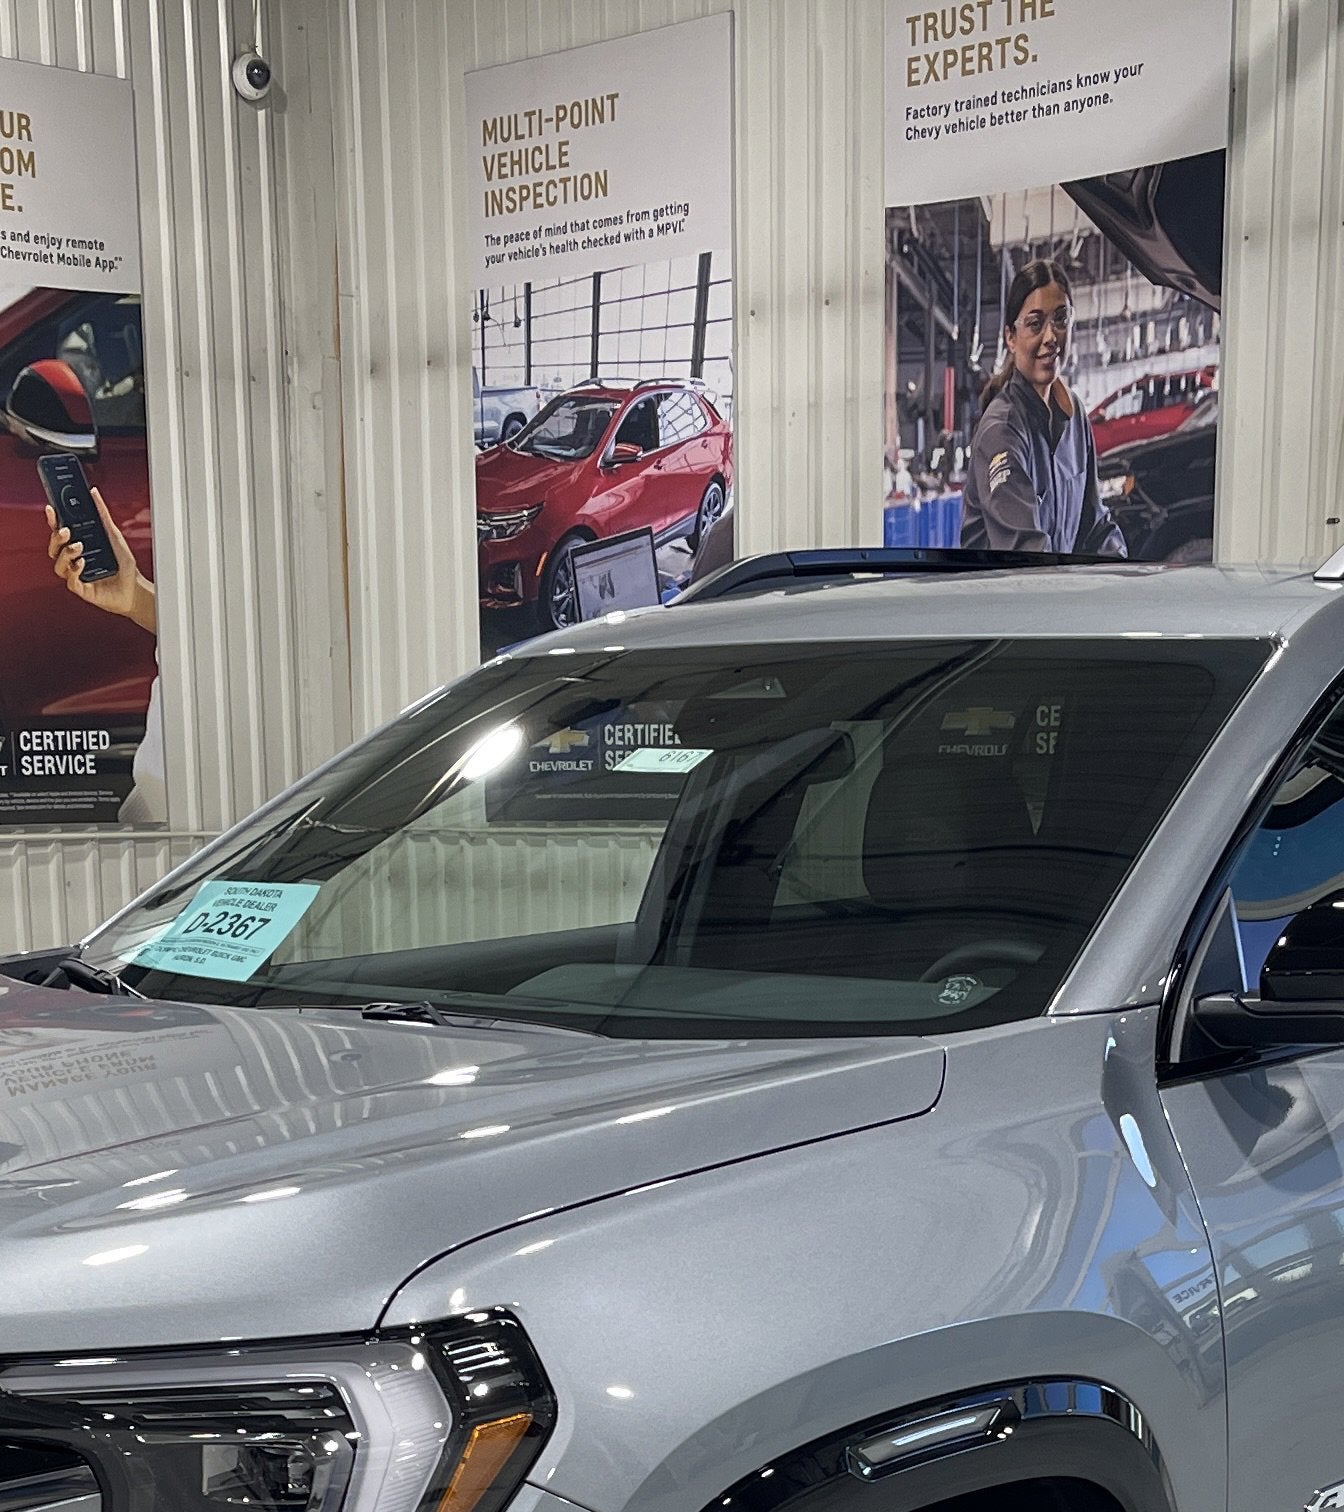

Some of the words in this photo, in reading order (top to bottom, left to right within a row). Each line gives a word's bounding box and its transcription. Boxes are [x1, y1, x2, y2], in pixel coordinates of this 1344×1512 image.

[906, 0, 993, 47] TRUST
[1000, 0, 1056, 27] THE
[907, 33, 1038, 87] EXPERTS.
[906, 101, 951, 121] Factory
[955, 91, 998, 112] trained
[1002, 79, 1073, 104] technicians
[1076, 70, 1110, 88] know
[1114, 63, 1145, 84] your
[482, 92, 619, 147] MULTI-POINT
[906, 124, 941, 141] Chevy
[945, 115, 986, 135] vehicle
[990, 109, 1028, 127] better
[1032, 101, 1059, 118] than
[1063, 91, 1114, 112] anyone.
[482, 140, 570, 182] VEHICLE
[484, 169, 608, 218] INSPECTION
[10, 229, 30, 243] and
[34, 231, 62, 250] enjoy
[66, 236, 105, 251] remote
[485, 232, 501, 248] The
[504, 230, 531, 248] peace
[533, 225, 543, 240] of
[545, 222, 568, 237] mind
[570, 218, 590, 233] that
[592, 214, 624, 230] comes
[626, 209, 650, 223] from
[653, 201, 690, 223] getting
[57, 253, 91, 268] Mobile
[485, 252, 505, 269] your
[507, 243, 547, 262] vehicle's
[549, 238, 579, 255] health
[581, 231, 621, 251] checked
[624, 226, 646, 242] with
[648, 228, 654, 239] a
[19, 730, 110, 751] CERTIFIED
[20, 754, 97, 776] SERVICE
[529, 760, 594, 773] CHEVROLET
[242, 899, 278, 912] DEALER
[249, 887, 283, 899] DAKOTA
[182, 911, 271, 940] D-2367
